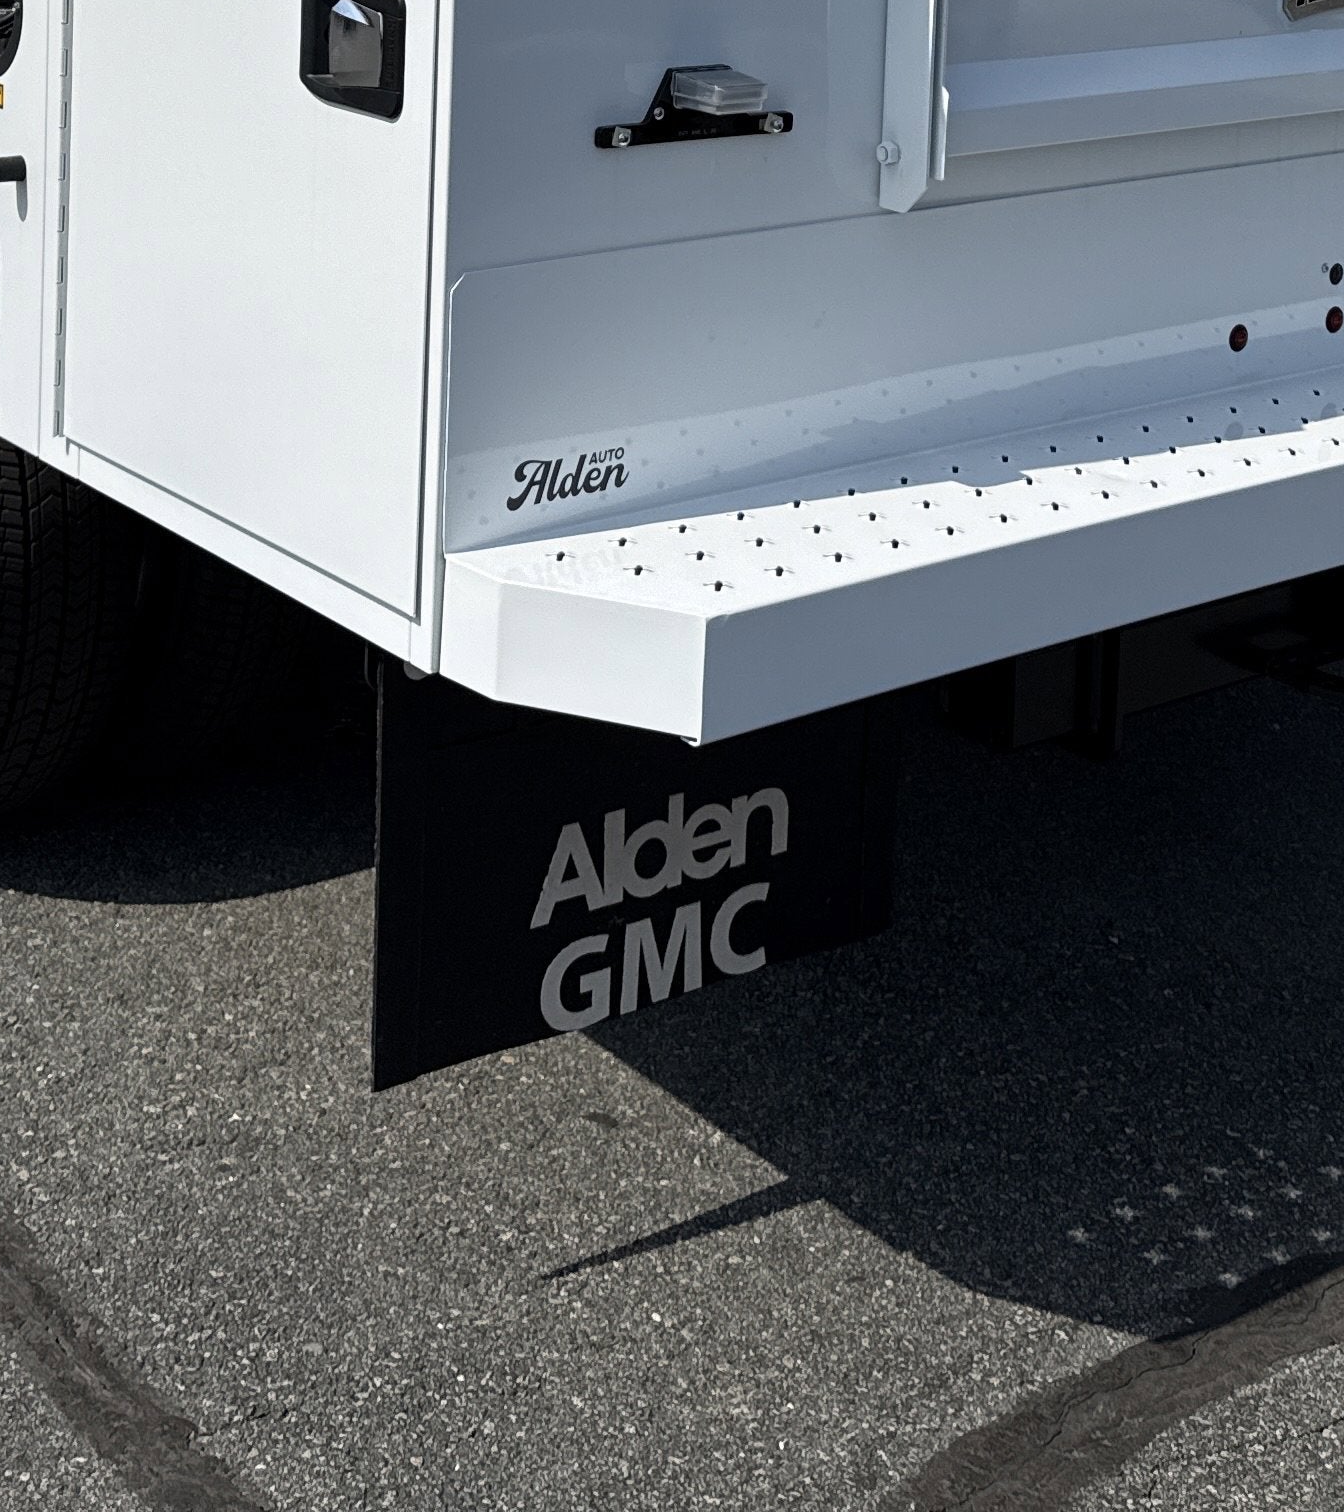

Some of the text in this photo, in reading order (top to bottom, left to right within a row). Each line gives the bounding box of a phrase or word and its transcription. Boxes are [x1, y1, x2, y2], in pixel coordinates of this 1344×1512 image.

[506, 453, 630, 511] Alden
[588, 446, 625, 466] AUTO
[529, 787, 789, 930] Alden
[540, 882, 770, 1032] GMC
